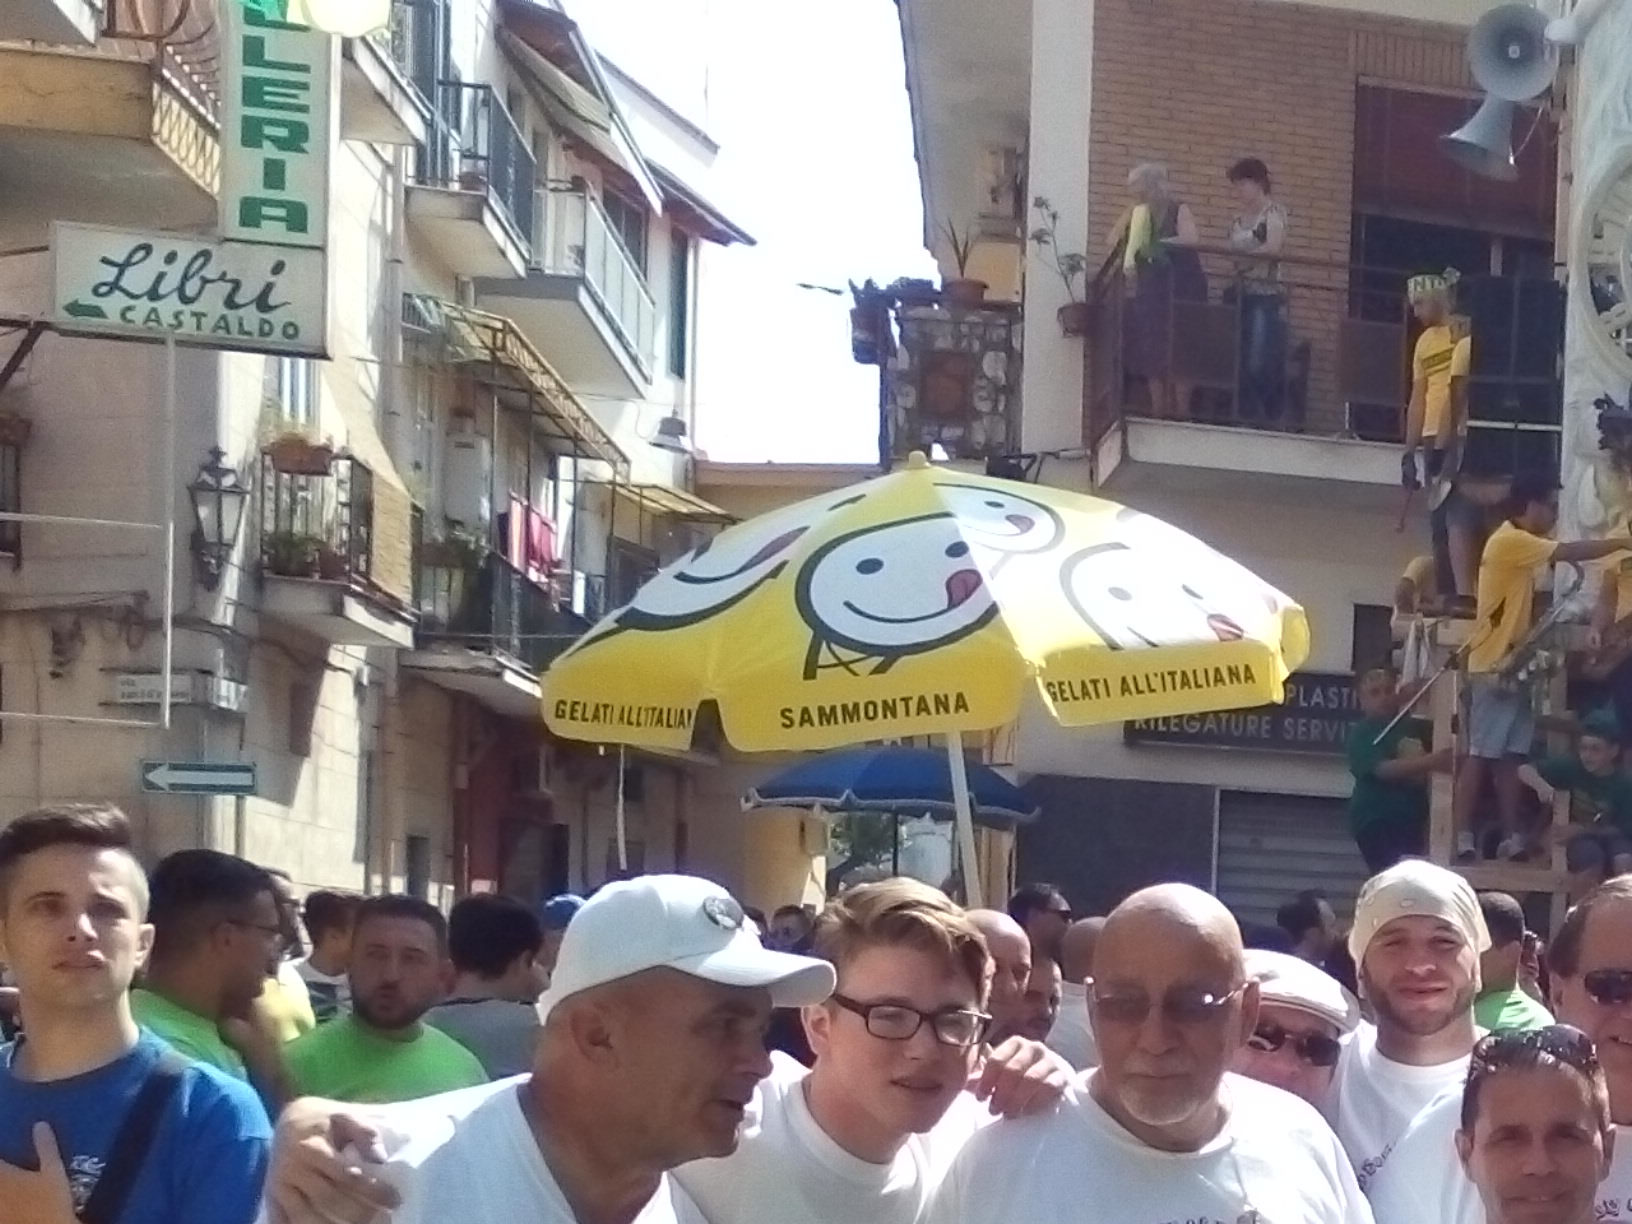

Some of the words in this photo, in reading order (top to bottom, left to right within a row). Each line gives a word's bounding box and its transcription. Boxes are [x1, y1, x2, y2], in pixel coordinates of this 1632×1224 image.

[91, 243, 291, 314] Libri
[119, 306, 299, 340] CASTALDO
[1046, 678, 1111, 703] GELATI
[1120, 663, 1257, 698] ALL'ITALIANA
[1286, 683, 1358, 709] PLASTI
[555, 699, 614, 725] GELATI
[780, 691, 970, 729] SAMMONTANA
